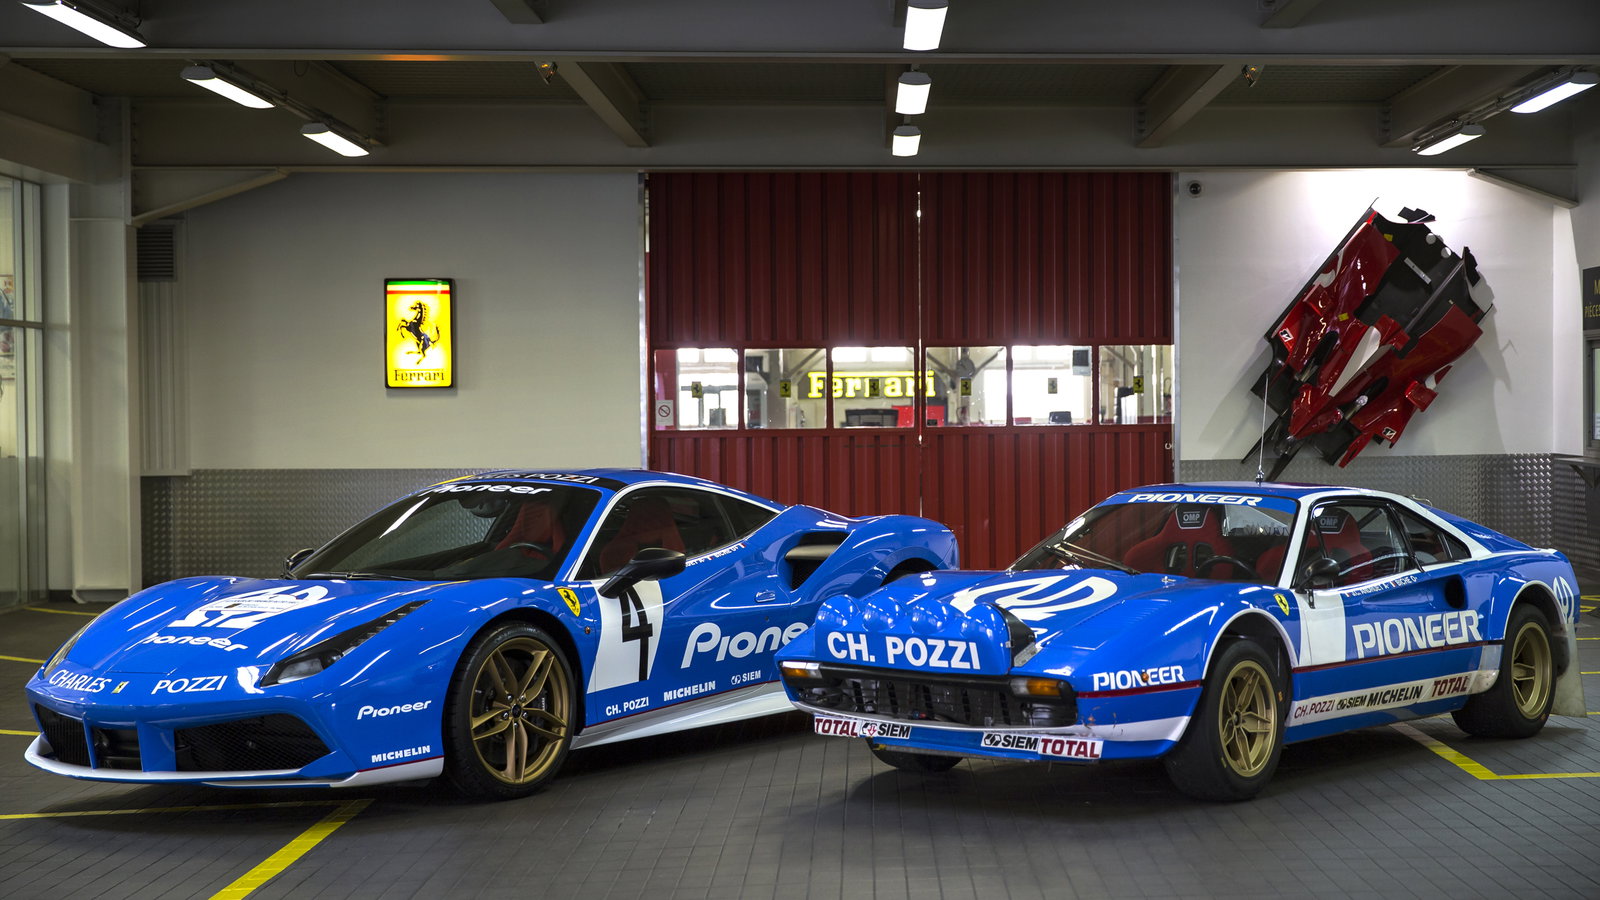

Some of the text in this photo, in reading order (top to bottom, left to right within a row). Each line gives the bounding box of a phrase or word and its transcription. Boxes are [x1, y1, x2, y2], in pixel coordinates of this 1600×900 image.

[394, 368, 445, 381] Ferrari
[1128, 493, 1263, 506] PIONEER
[1320, 517, 1338, 526] OMP
[617, 589, 653, 682] 4
[1352, 610, 1483, 659] PIONEER
[681, 622, 809, 669] Pione
[827, 631, 981, 670] CH. POZZI
[49, 669, 228, 695] CHARLES POZZI
[742, 670, 762, 682] SIEM
[1093, 665, 1186, 691] PIONEER
[663, 681, 716, 702] MICHELIN
[1346, 695, 1366, 708] SIEM
[1366, 686, 1424, 708] MICHELIN
[1432, 676, 1469, 697] TOTAL
[357, 700, 432, 720] Pioneer
[606, 697, 649, 716] CH. POZZI
[815, 718, 911, 738] TOTAL SIEM
[371, 745, 431, 763] MICHELIN
[1001, 734, 1100, 758] SIEM TOTAL
